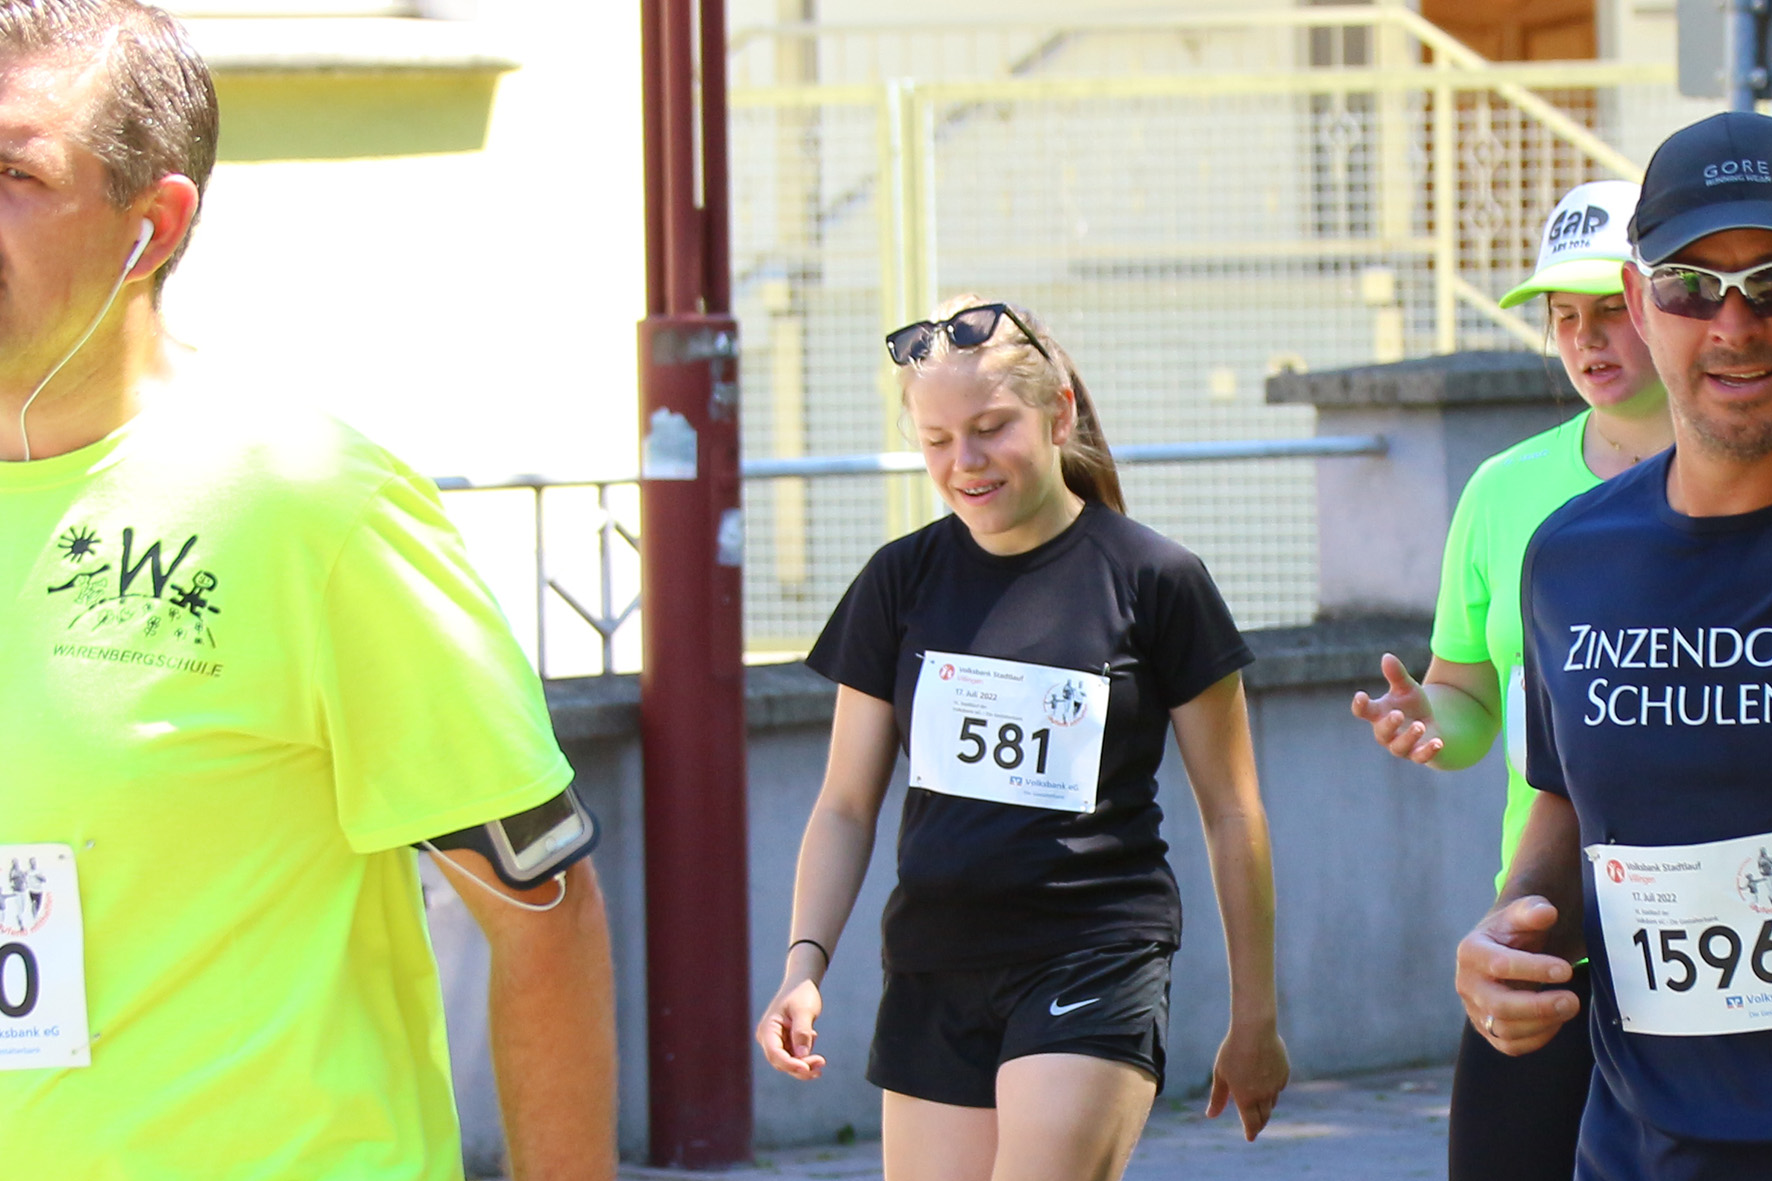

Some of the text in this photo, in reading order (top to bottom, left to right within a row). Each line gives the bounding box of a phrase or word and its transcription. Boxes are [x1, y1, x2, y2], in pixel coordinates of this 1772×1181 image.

[1703, 159, 1770, 178] GORE
[53, 643, 223, 678] WARENBERGSCHULE
[993, 671, 1024, 681] Stadtlauf
[980, 692, 998, 701] 2022
[957, 717, 1050, 774] 581
[1025, 779, 1066, 790] Volksbank
[1662, 861, 1701, 872] Stadtlauf
[1656, 893, 1678, 903] 2022
[0, 942, 40, 1018] 0
[44, 1026, 60, 1037] eG
